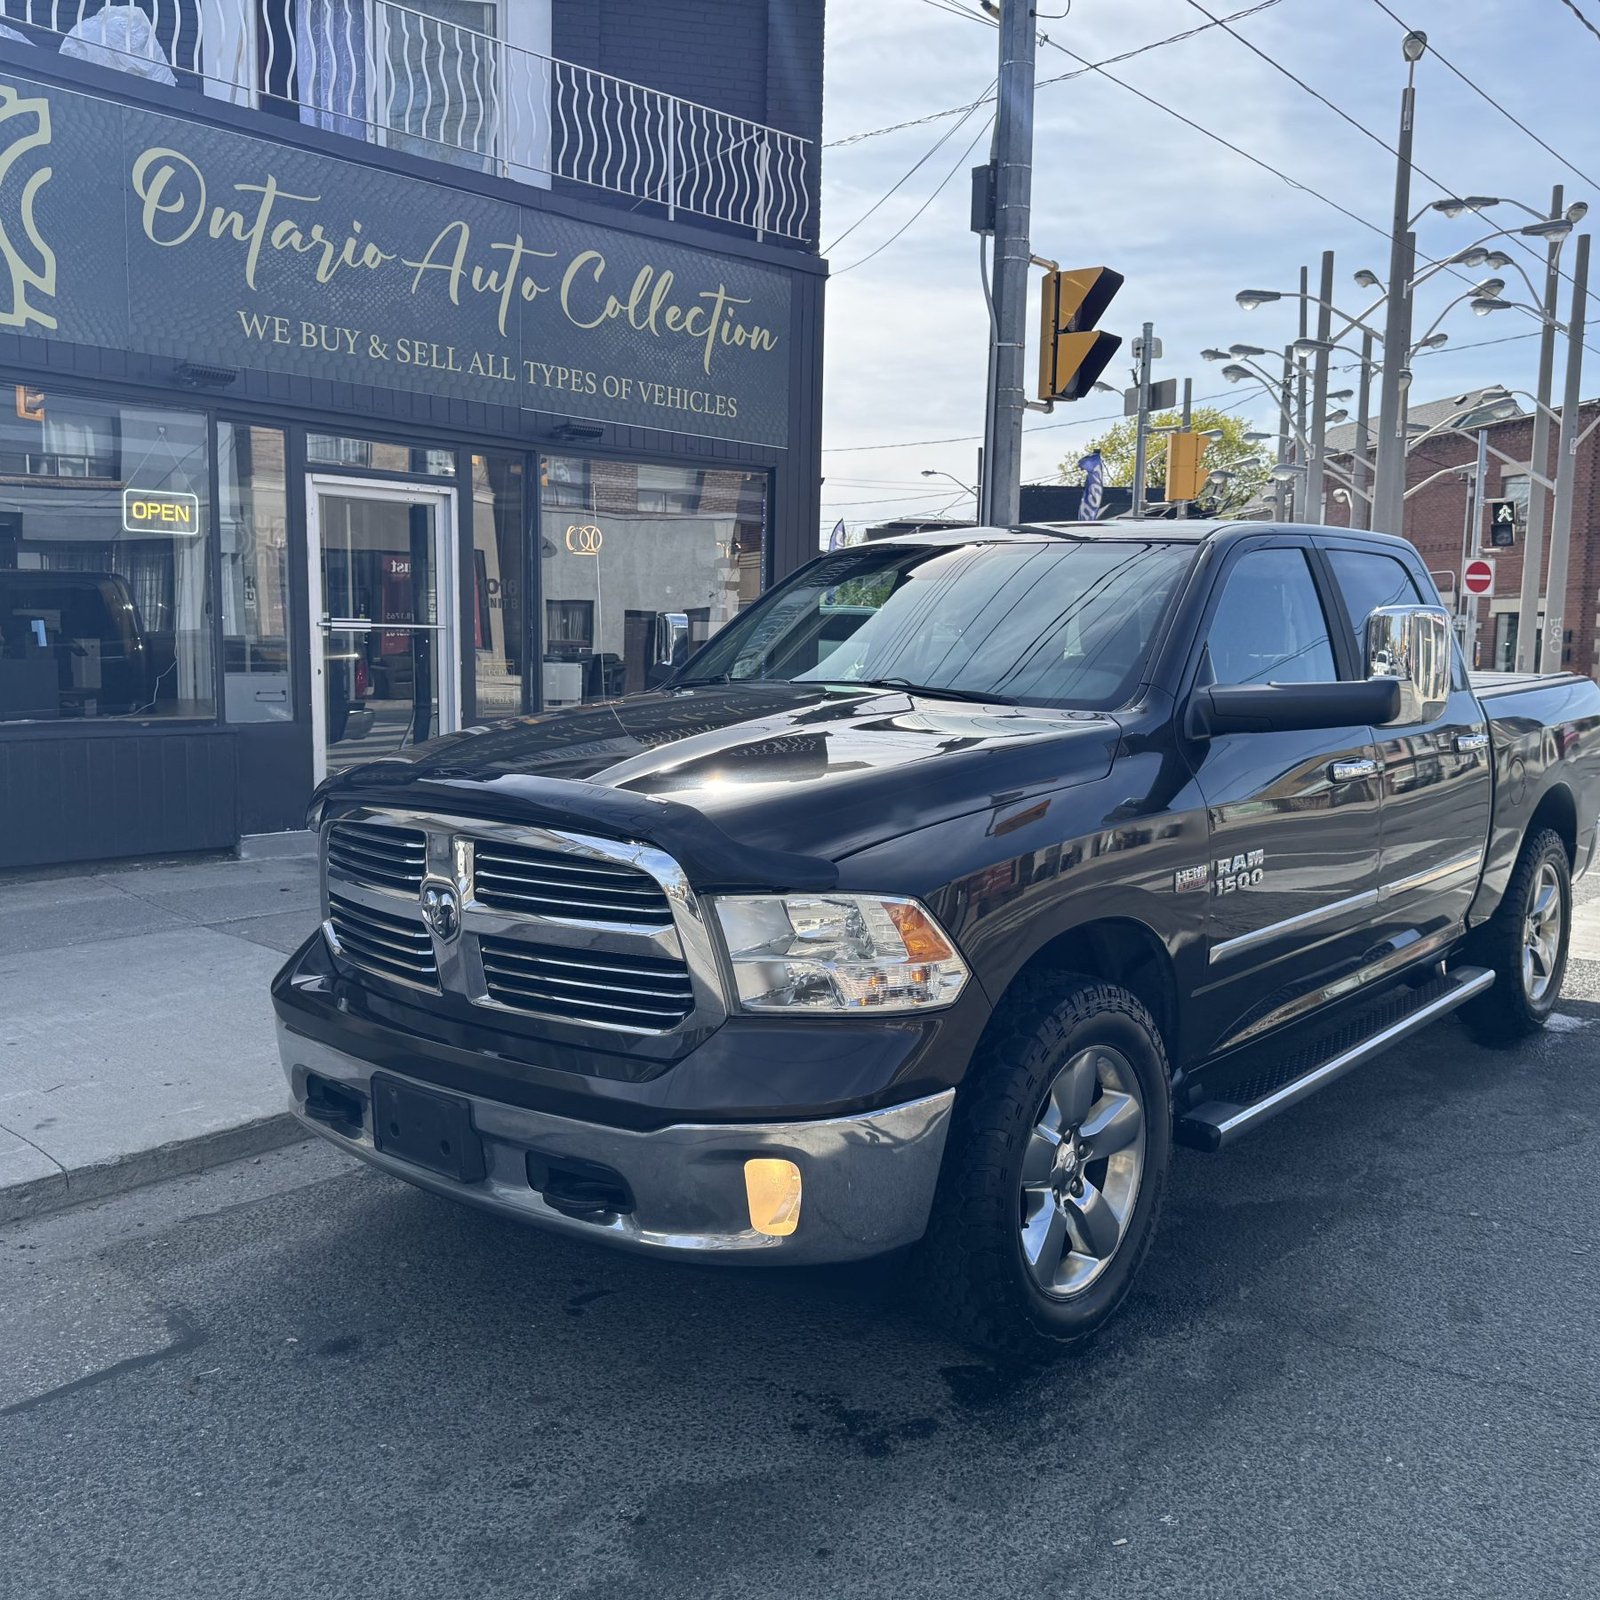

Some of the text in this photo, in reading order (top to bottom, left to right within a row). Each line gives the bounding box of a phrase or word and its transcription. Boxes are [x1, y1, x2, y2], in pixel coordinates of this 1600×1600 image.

[132, 147, 779, 375] Ontario Auto Collection
[236, 310, 738, 418] WE BUY & SELL ALL TYPES OF VEHICLES
[132, 501, 190, 523] OPEN
[481, 597, 508, 609] UNIT
[1176, 865, 1207, 883] HEMI
[1217, 848, 1264, 877] RAM
[1216, 868, 1264, 897] 1500
